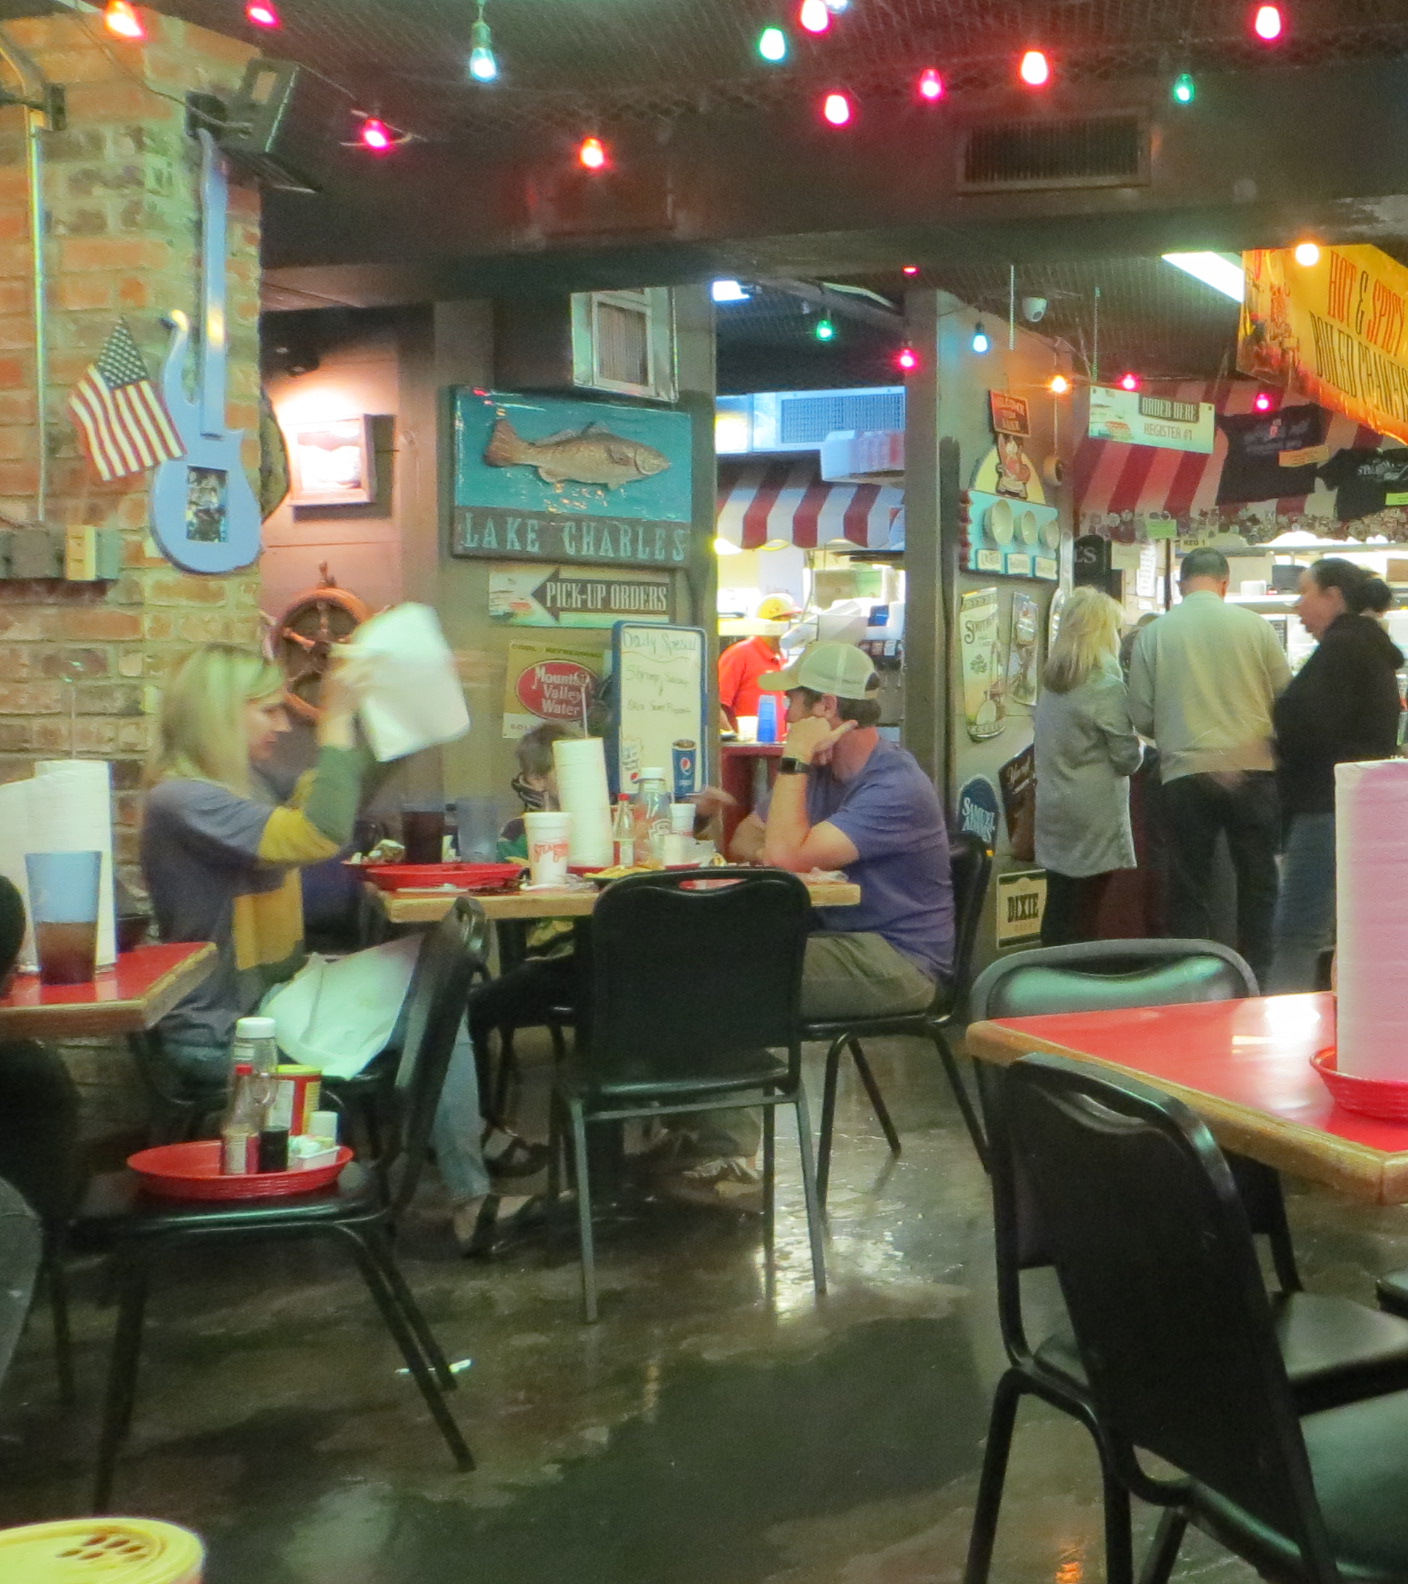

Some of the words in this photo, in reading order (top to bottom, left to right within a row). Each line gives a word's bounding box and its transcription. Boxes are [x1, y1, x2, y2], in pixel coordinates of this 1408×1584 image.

[1327, 250, 1358, 328] HOT
[1355, 270, 1369, 335] &
[1366, 279, 1405, 357] SPICY
[1308, 310, 1357, 398] BOILED
[1141, 397, 1173, 418] ORDER
[1174, 400, 1199, 422] HERE
[1143, 422, 1181, 439] REGISTER
[1182, 427, 1193, 441] #1
[462, 511, 542, 553] LAKE
[561, 519, 690, 562] CHARLES
[546, 580, 607, 609] PICK-UP
[609, 584, 668, 612] ORDERS
[542, 699, 581, 716] Water
[544, 684, 582, 703] Valley
[1007, 892, 1040, 923] DIXIE
